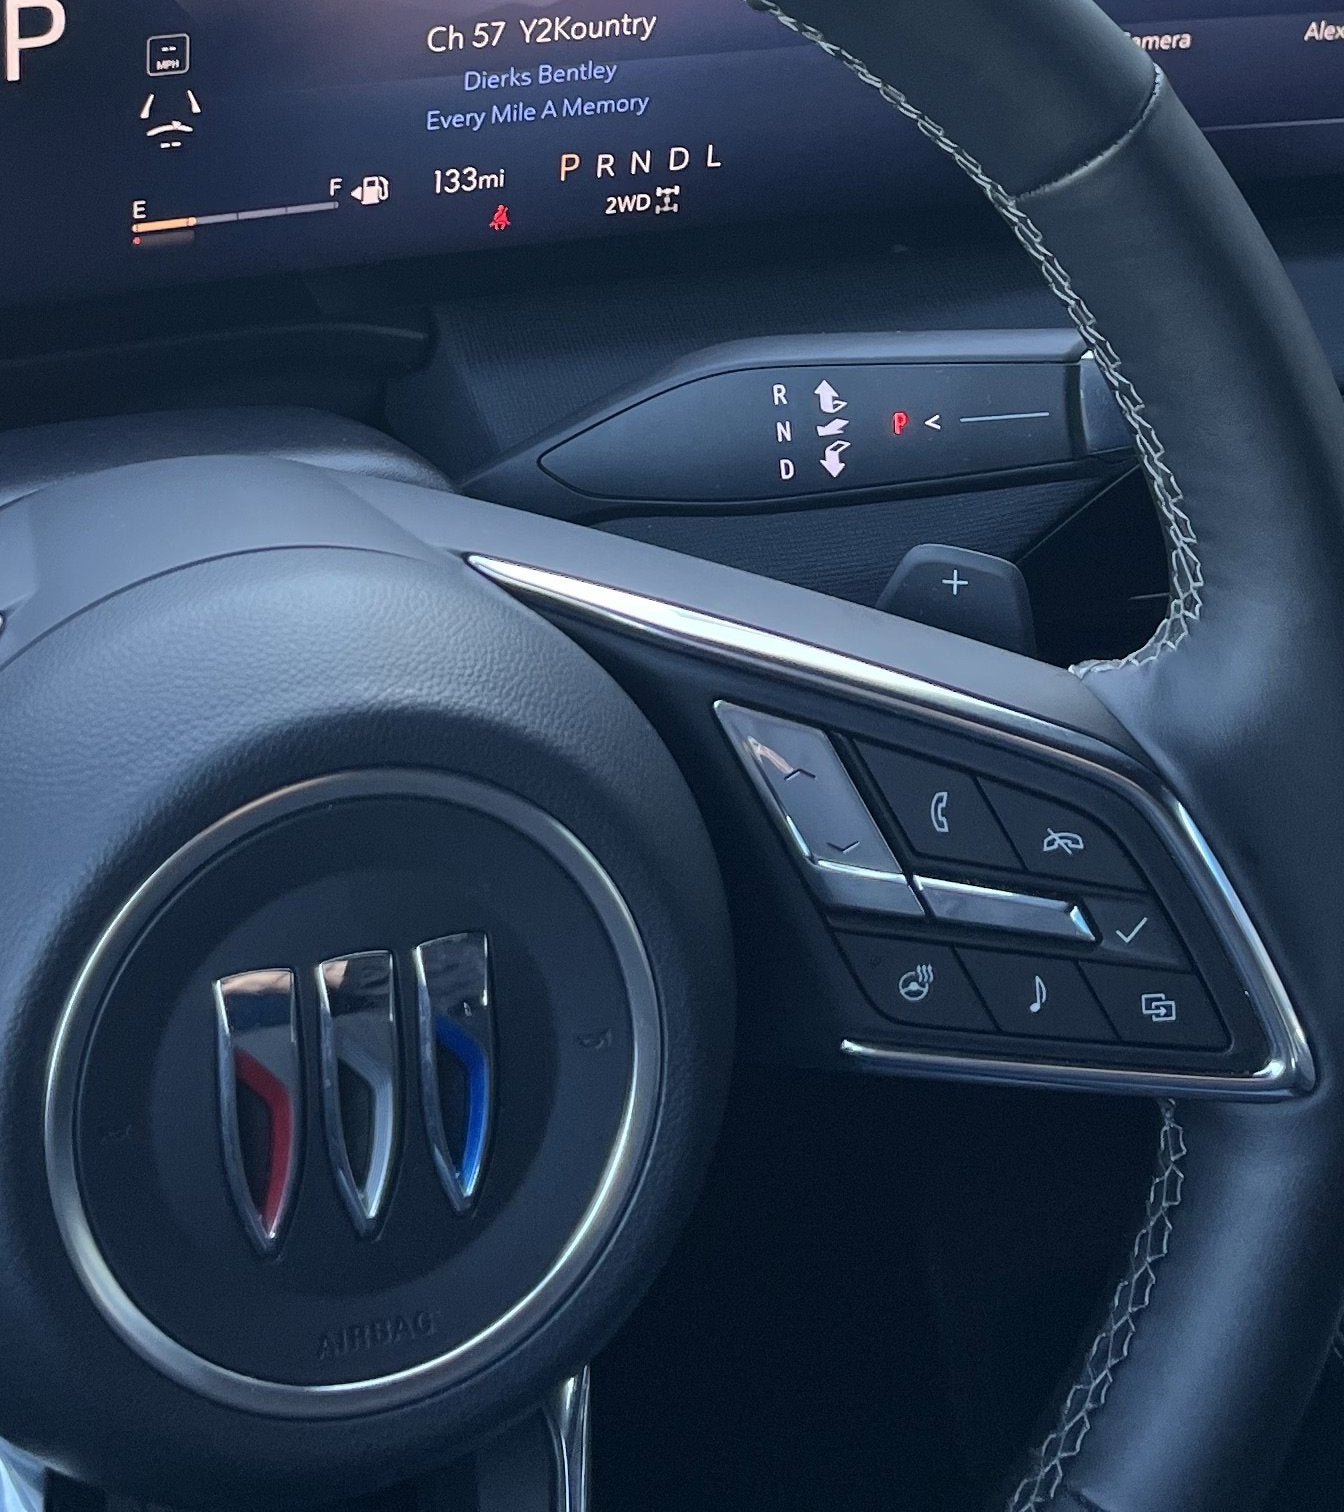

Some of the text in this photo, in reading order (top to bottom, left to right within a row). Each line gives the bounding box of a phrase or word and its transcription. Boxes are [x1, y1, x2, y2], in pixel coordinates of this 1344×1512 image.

[426, 13, 657, 53] Ch 57 Y2Kountry
[1123, 31, 1192, 51] amera
[156, 58, 180, 71] MPH
[464, 60, 618, 91] Dierks Bentley
[426, 96, 650, 132] Every Mile A Memory
[559, 144, 722, 182] P R N D L
[329, 177, 343, 197] F
[433, 166, 506, 195] 133mi
[132, 199, 147, 220] E
[605, 193, 651, 215] 2WD
[772, 383, 788, 406] R
[776, 420, 793, 443] N
[892, 411, 907, 436] P
[779, 458, 795, 481] D
